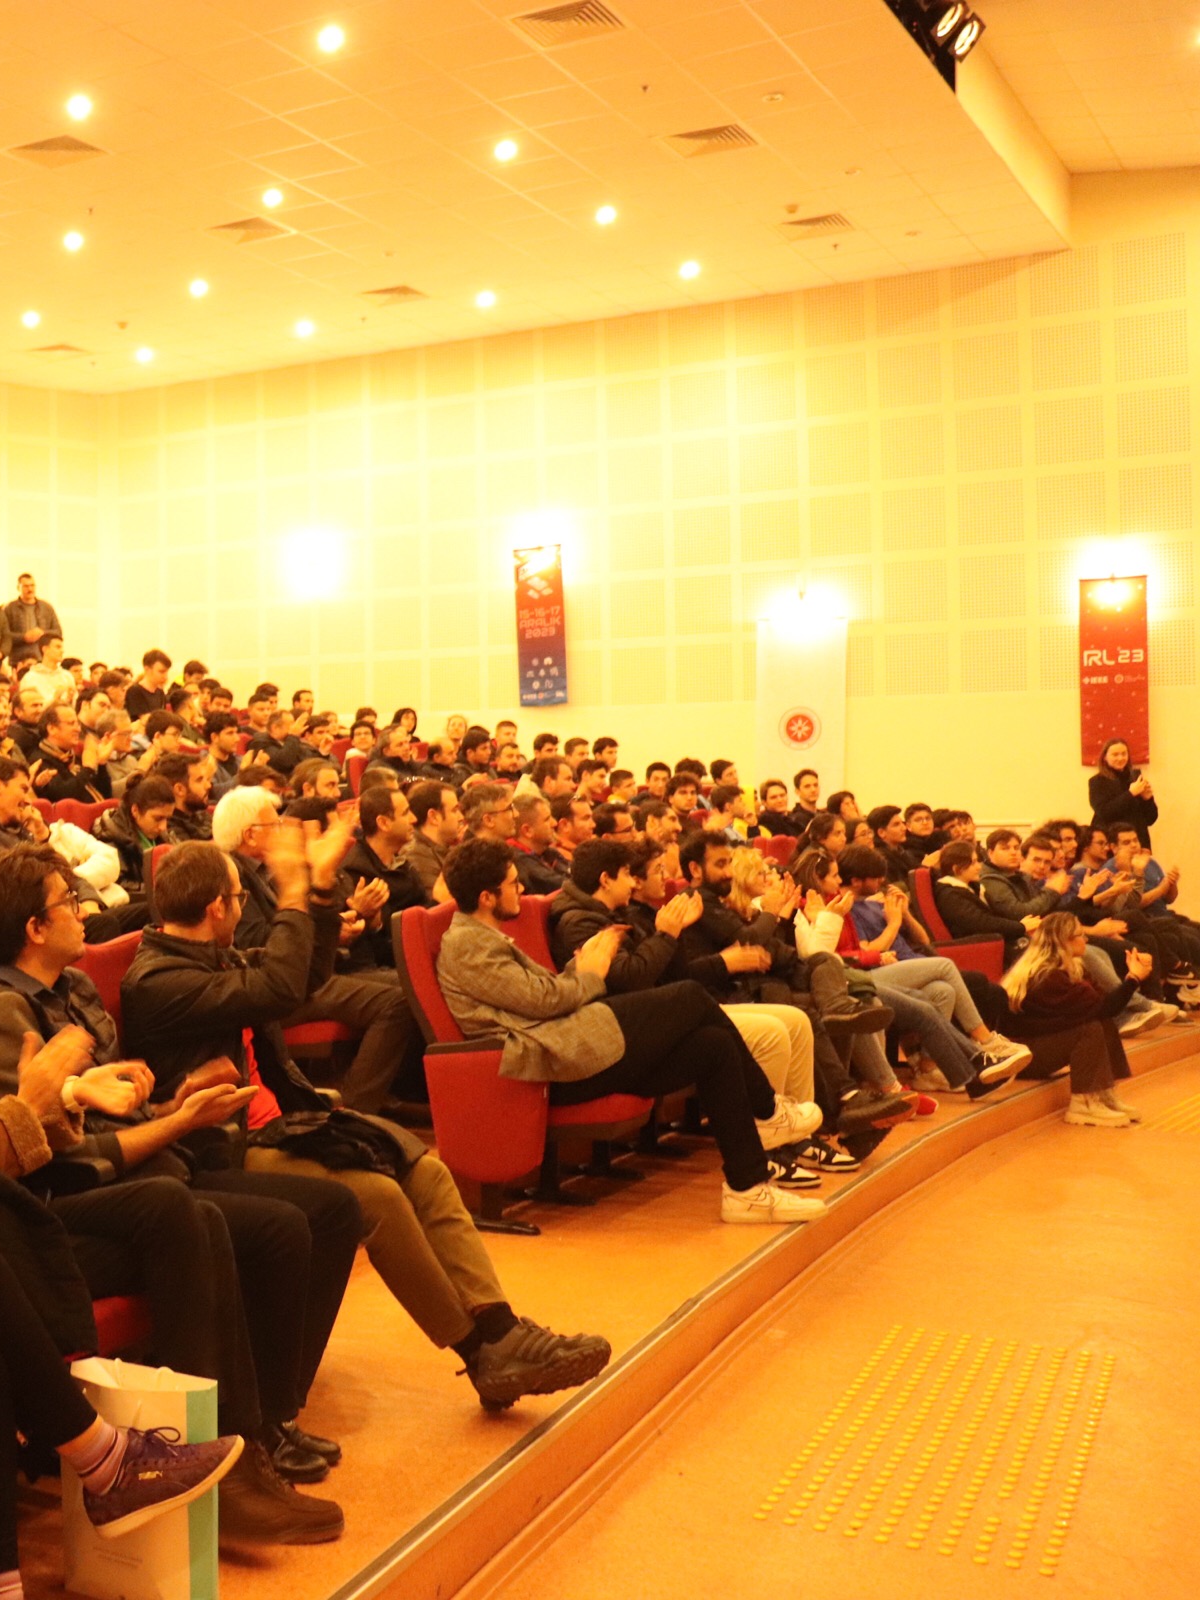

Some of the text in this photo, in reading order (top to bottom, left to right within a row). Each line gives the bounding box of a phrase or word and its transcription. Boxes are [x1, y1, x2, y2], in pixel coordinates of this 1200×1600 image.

[519, 615, 561, 629] ARALIK
[525, 626, 556, 639] 2023
[1117, 648, 1145, 663] 23
